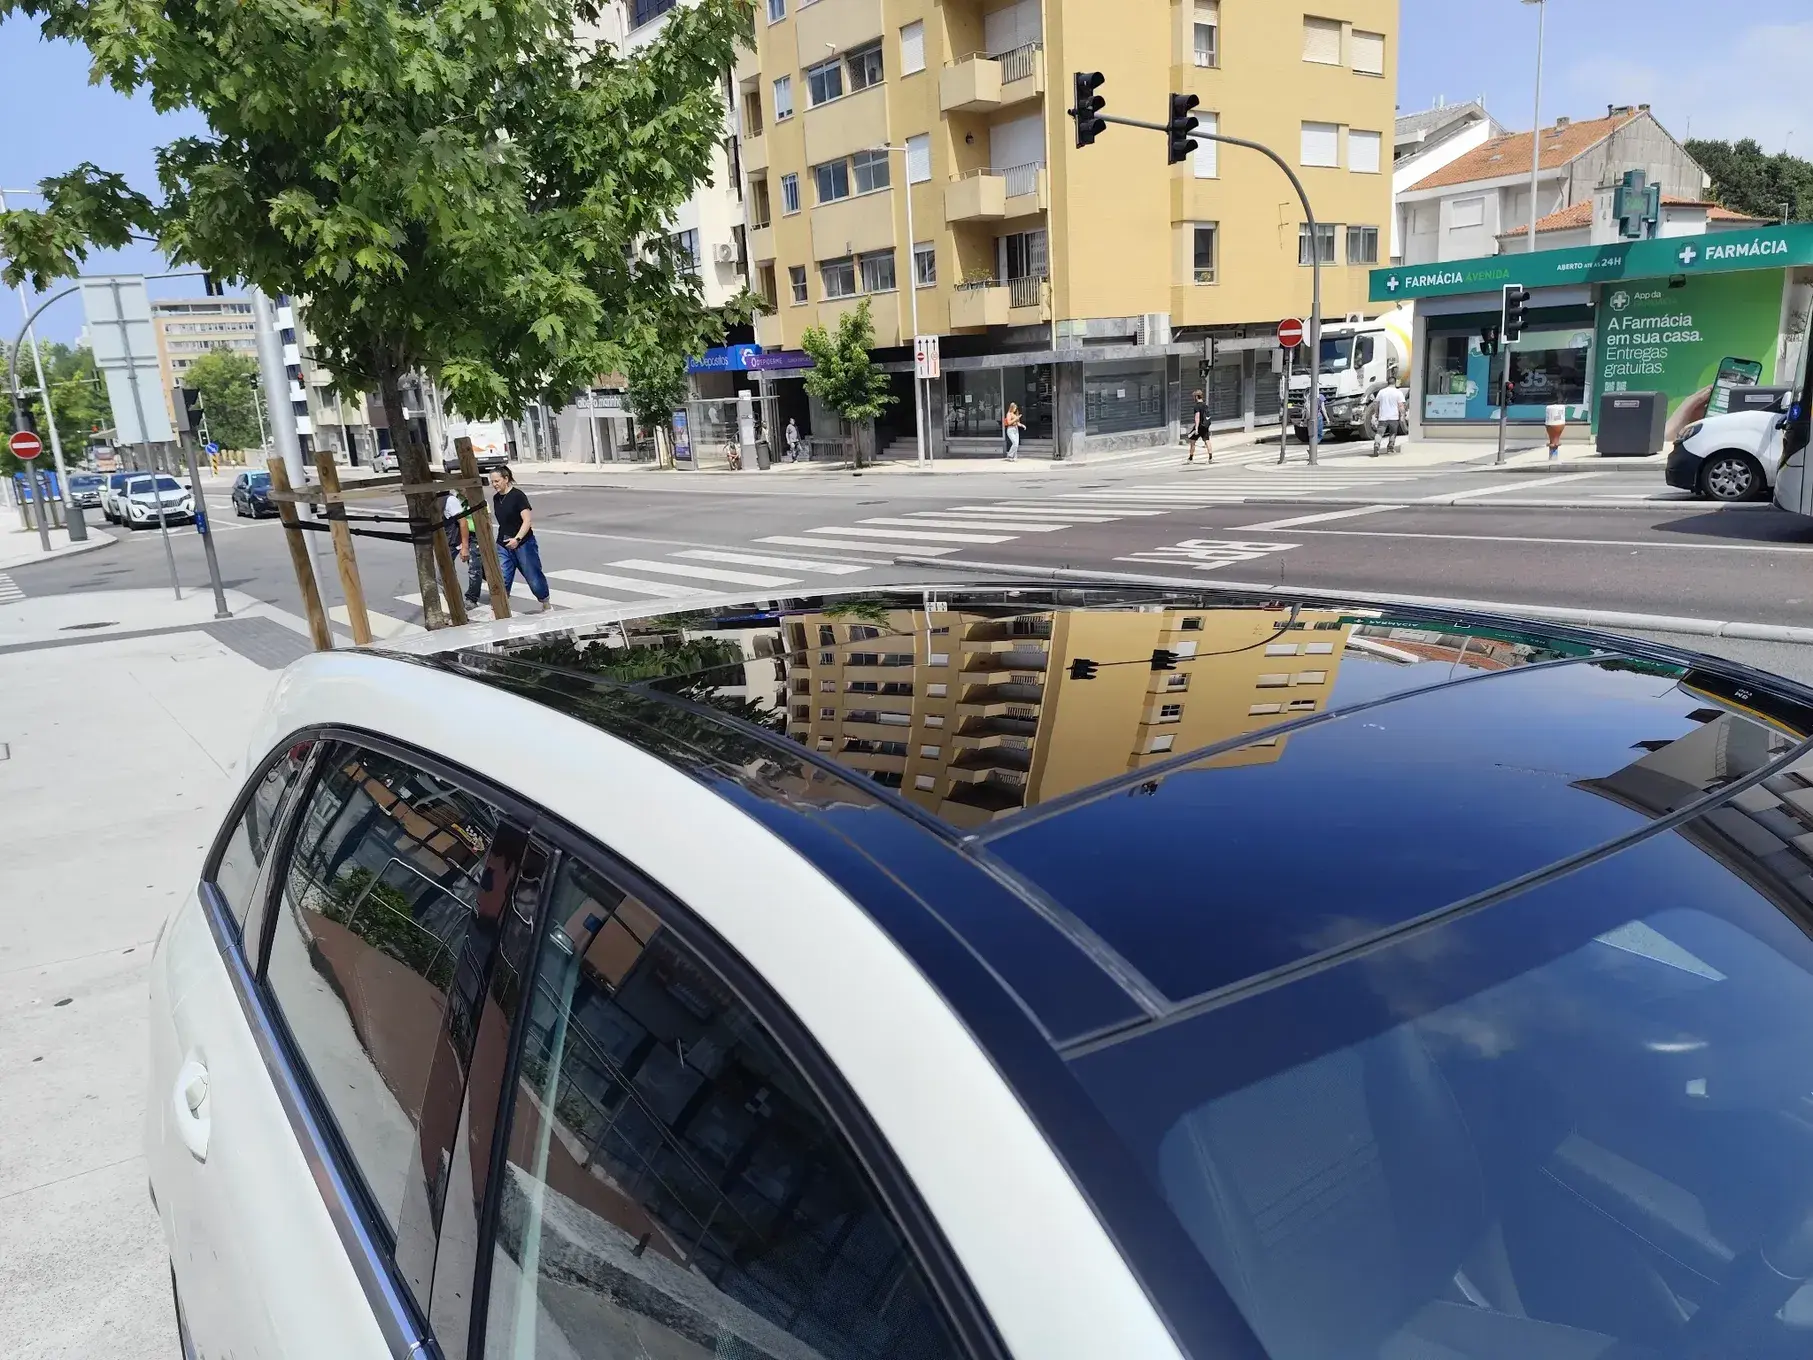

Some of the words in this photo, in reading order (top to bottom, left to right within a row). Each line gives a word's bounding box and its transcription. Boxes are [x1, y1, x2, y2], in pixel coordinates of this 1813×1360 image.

[1705, 238, 1788, 260] FARMÁCIA
[1556, 262, 1583, 271] ABERTO
[1405, 271, 1463, 288] FARMÁCIA
[1633, 292, 1650, 300] App
[1651, 290, 1662, 299] da
[1607, 317, 1620, 330] A
[1622, 312, 1692, 330] Farmácia
[1606, 333, 1630, 345] em
[1632, 332, 1660, 344] sua
[1662, 330, 1704, 343] casa.
[1606, 346, 1668, 362] Entregas
[1603, 361, 1665, 378] gratuitas.
[1111, 538, 1304, 571] BRT
